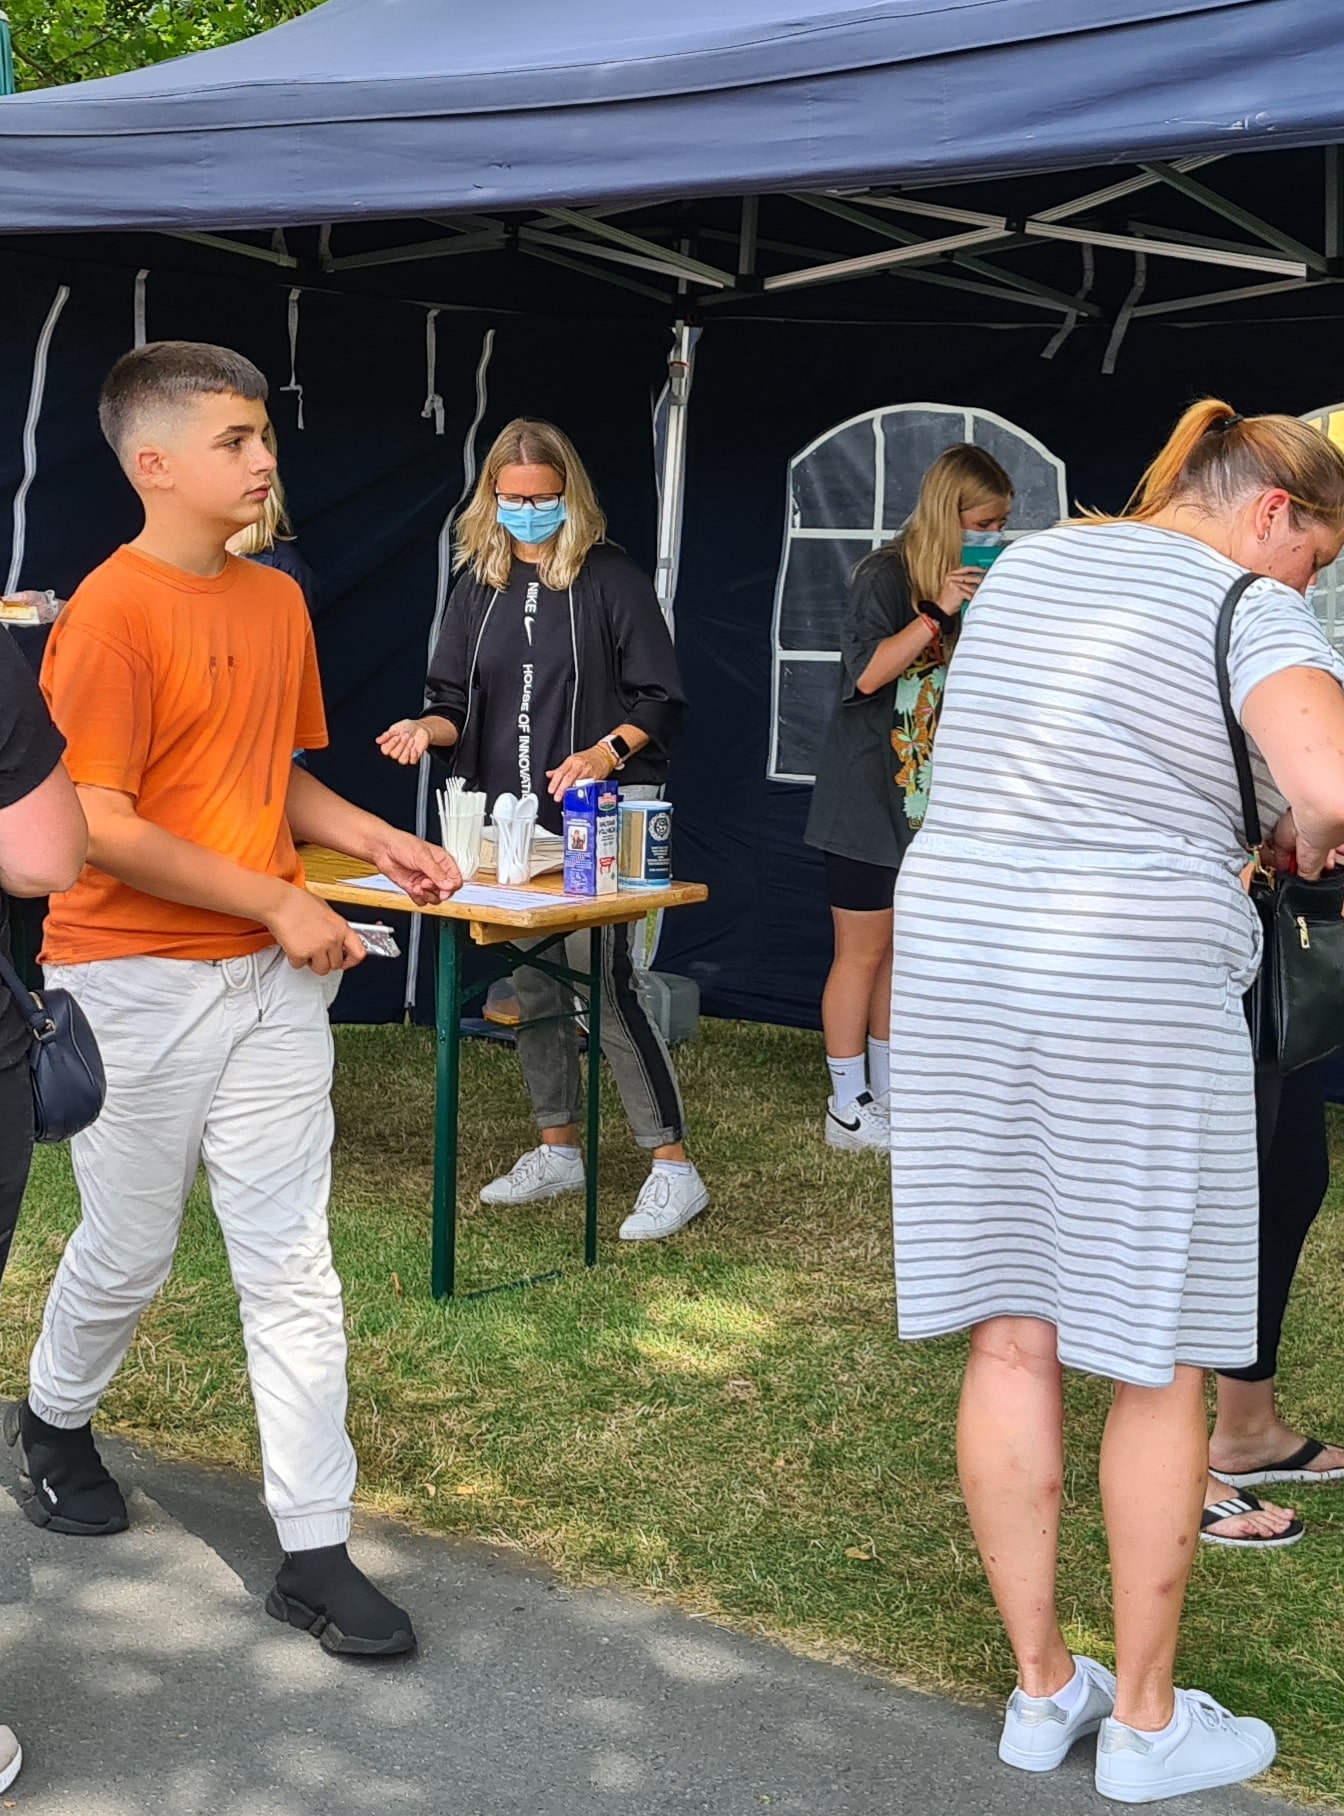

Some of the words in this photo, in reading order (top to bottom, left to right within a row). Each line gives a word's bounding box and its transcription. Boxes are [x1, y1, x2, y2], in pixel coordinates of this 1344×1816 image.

[524, 582, 539, 613] NIKE
[521, 664, 533, 711] HOUSE
[518, 714, 530, 733] OF
